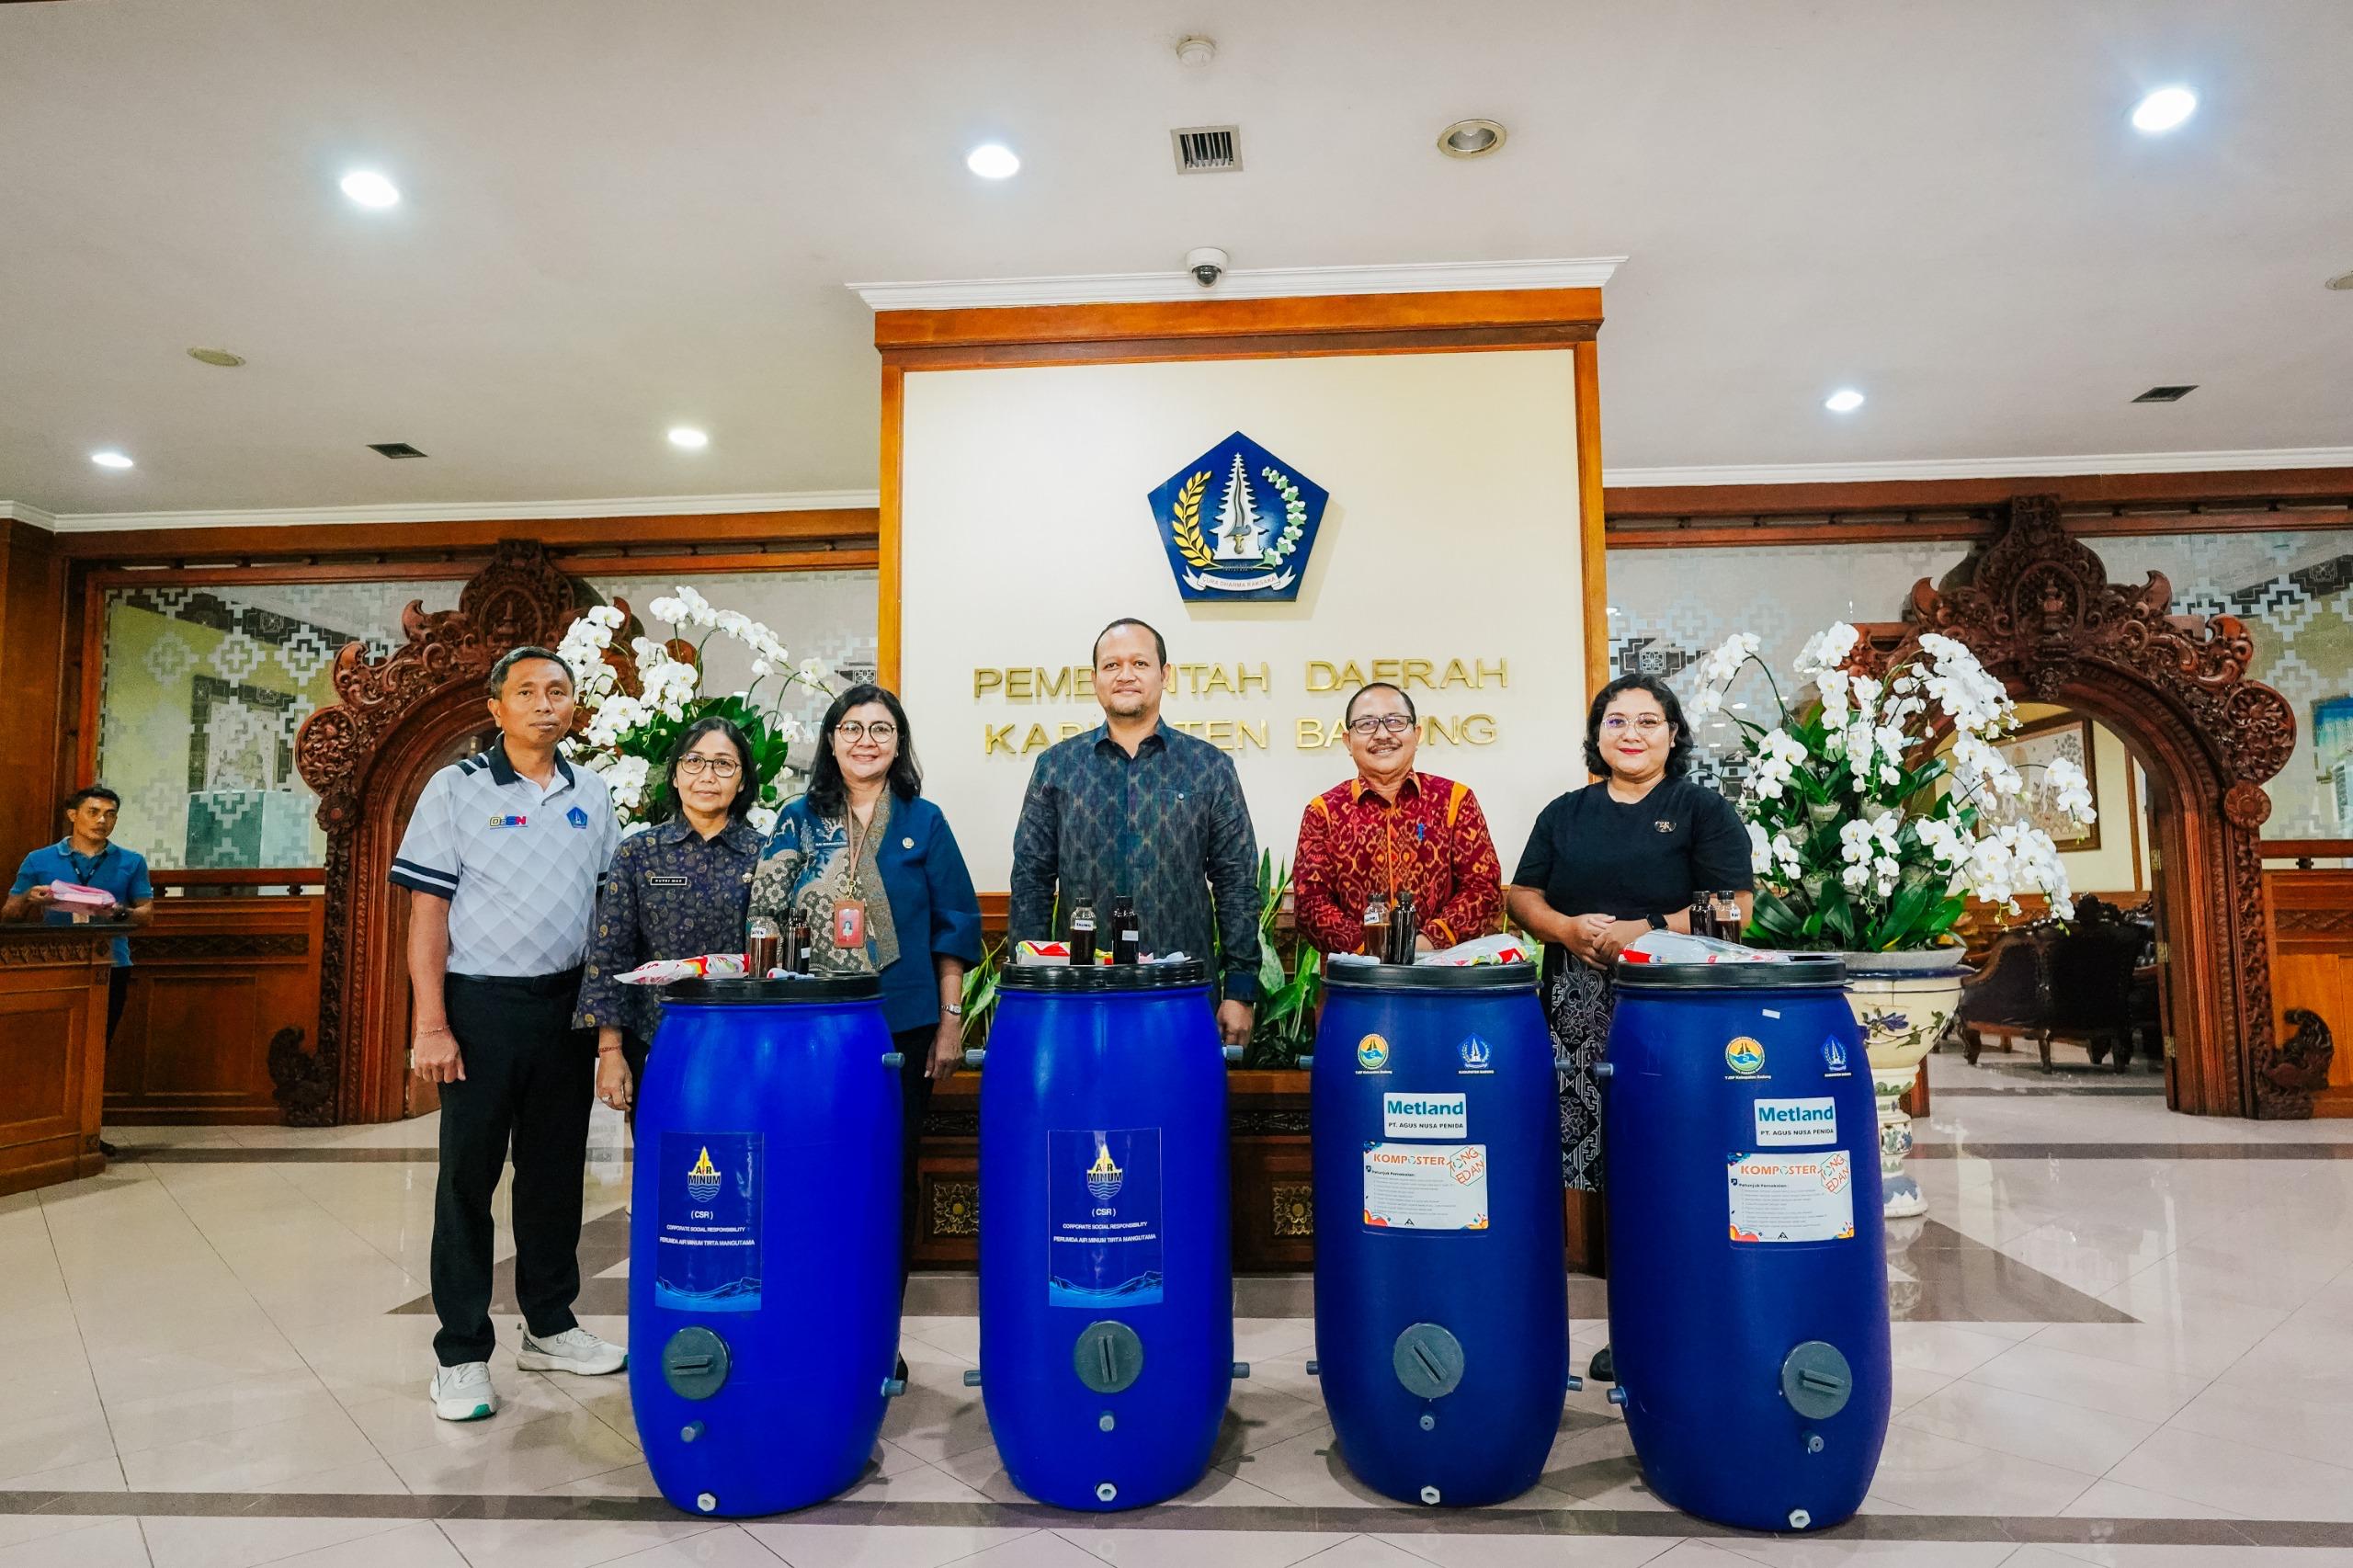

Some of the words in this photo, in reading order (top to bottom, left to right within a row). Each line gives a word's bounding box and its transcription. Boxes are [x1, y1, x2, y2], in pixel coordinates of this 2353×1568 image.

[1388, 1100, 1463, 1115] Metland
[1758, 1106, 1834, 1121] Metland
[1373, 1153, 1445, 1165] KOMPOSTER
[1456, 1160, 1484, 1184] EDAN
[1740, 1165, 1816, 1176] KOMPOSTER
[688, 1176, 721, 1185] MINUM
[1087, 1172, 1122, 1182] MINUM
[1826, 1166, 1850, 1192] EDAN
[1109, 1221, 1147, 1230] RESPONSIBILITY
[1123, 1233, 1156, 1243] MANGUTAMA
